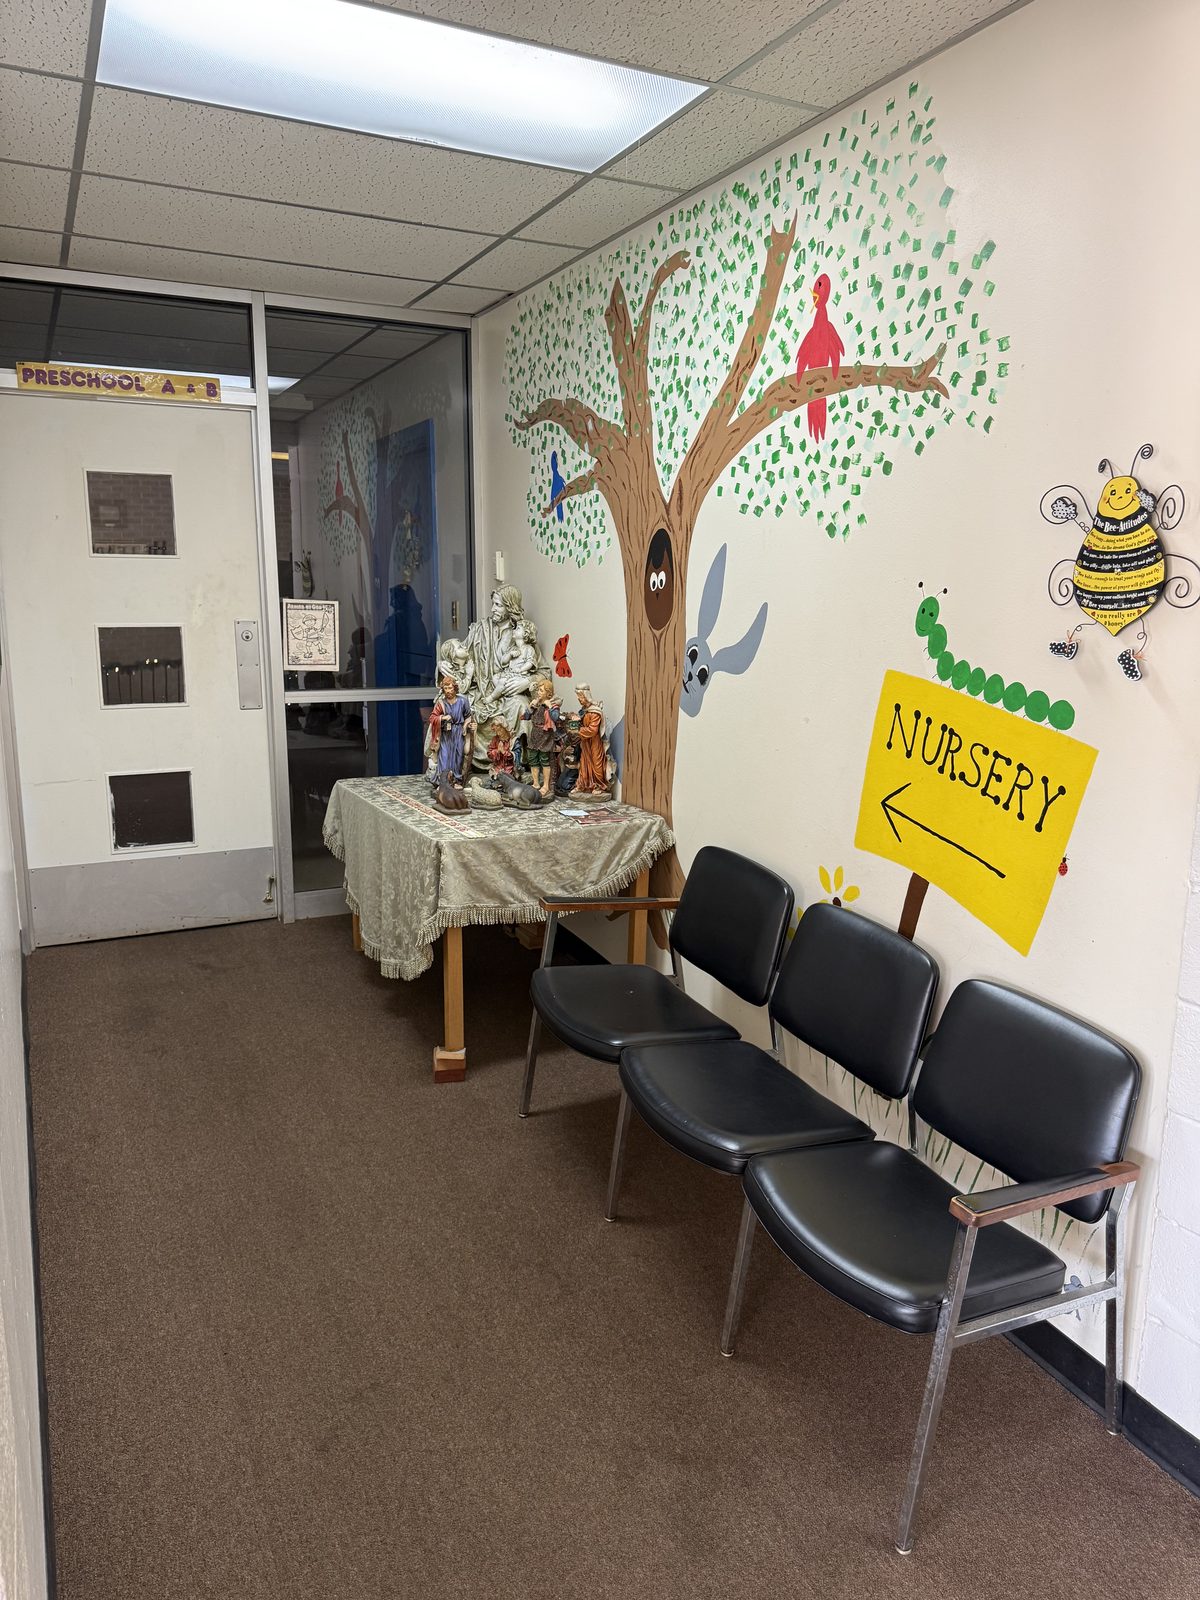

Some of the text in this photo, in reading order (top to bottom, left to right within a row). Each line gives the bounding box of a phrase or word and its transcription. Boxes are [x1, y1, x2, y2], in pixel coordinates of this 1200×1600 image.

[22, 367, 145, 392] PRESCHOOL
[161, 379, 175, 394] A
[206, 382, 218, 397] B
[1094, 511, 1148, 532] The Bee-Attitudes
[887, 703, 1067, 833] NURSERY
